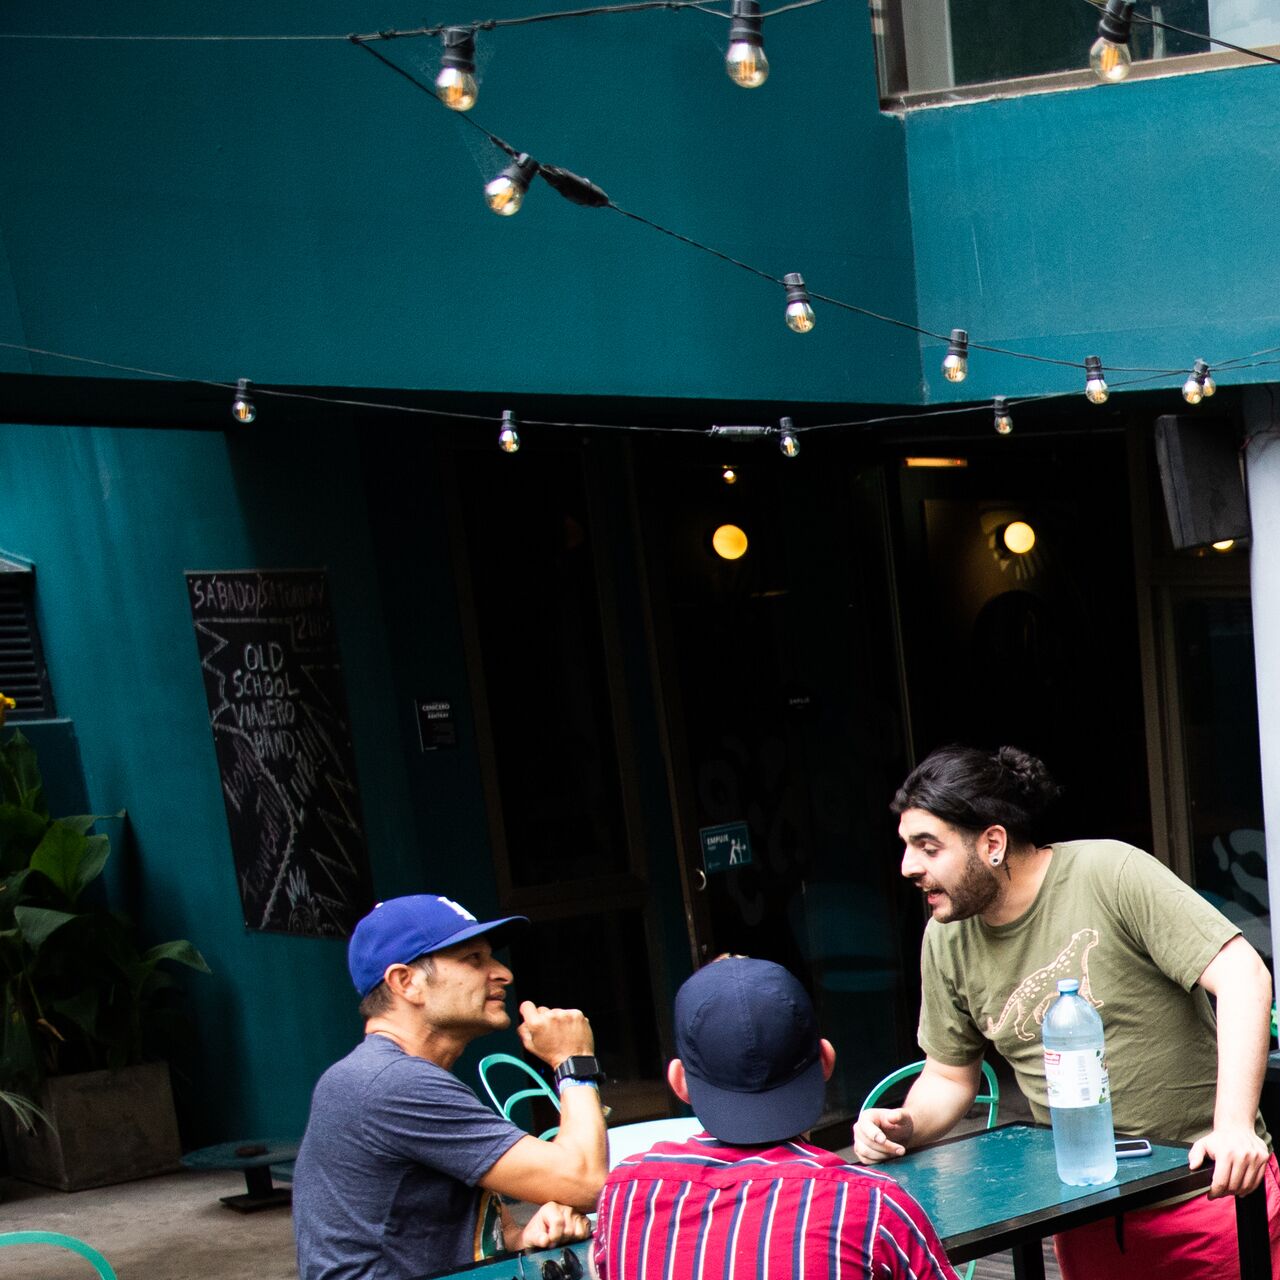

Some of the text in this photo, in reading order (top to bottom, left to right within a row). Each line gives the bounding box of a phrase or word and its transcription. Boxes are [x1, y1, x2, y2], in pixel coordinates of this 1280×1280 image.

[244, 642, 283, 673] OLD
[232, 668, 301, 698] SCHOOL
[230, 699, 295, 727] VIAJERO
[253, 729, 296, 760] BAND
